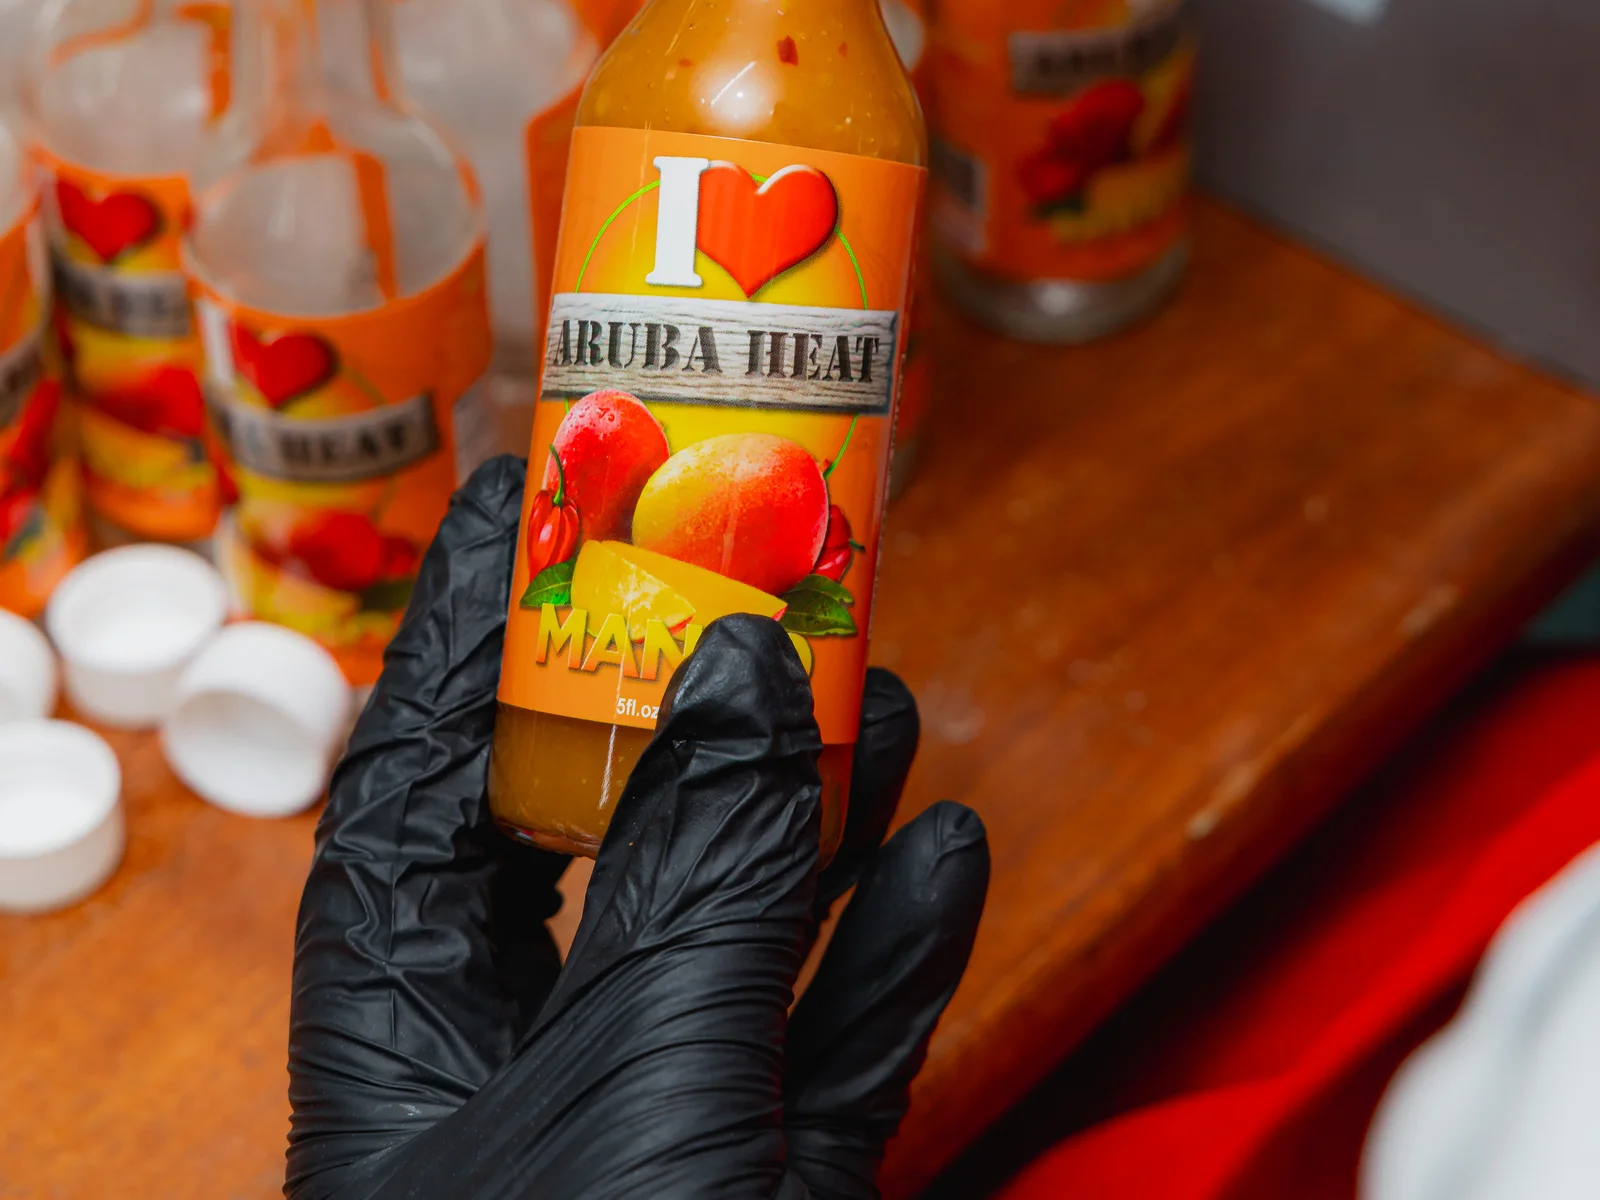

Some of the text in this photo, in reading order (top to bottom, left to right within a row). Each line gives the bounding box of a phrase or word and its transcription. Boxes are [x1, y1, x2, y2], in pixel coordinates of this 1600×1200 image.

[645, 156, 708, 287] I
[553, 319, 880, 384] ARUBA HEAT
